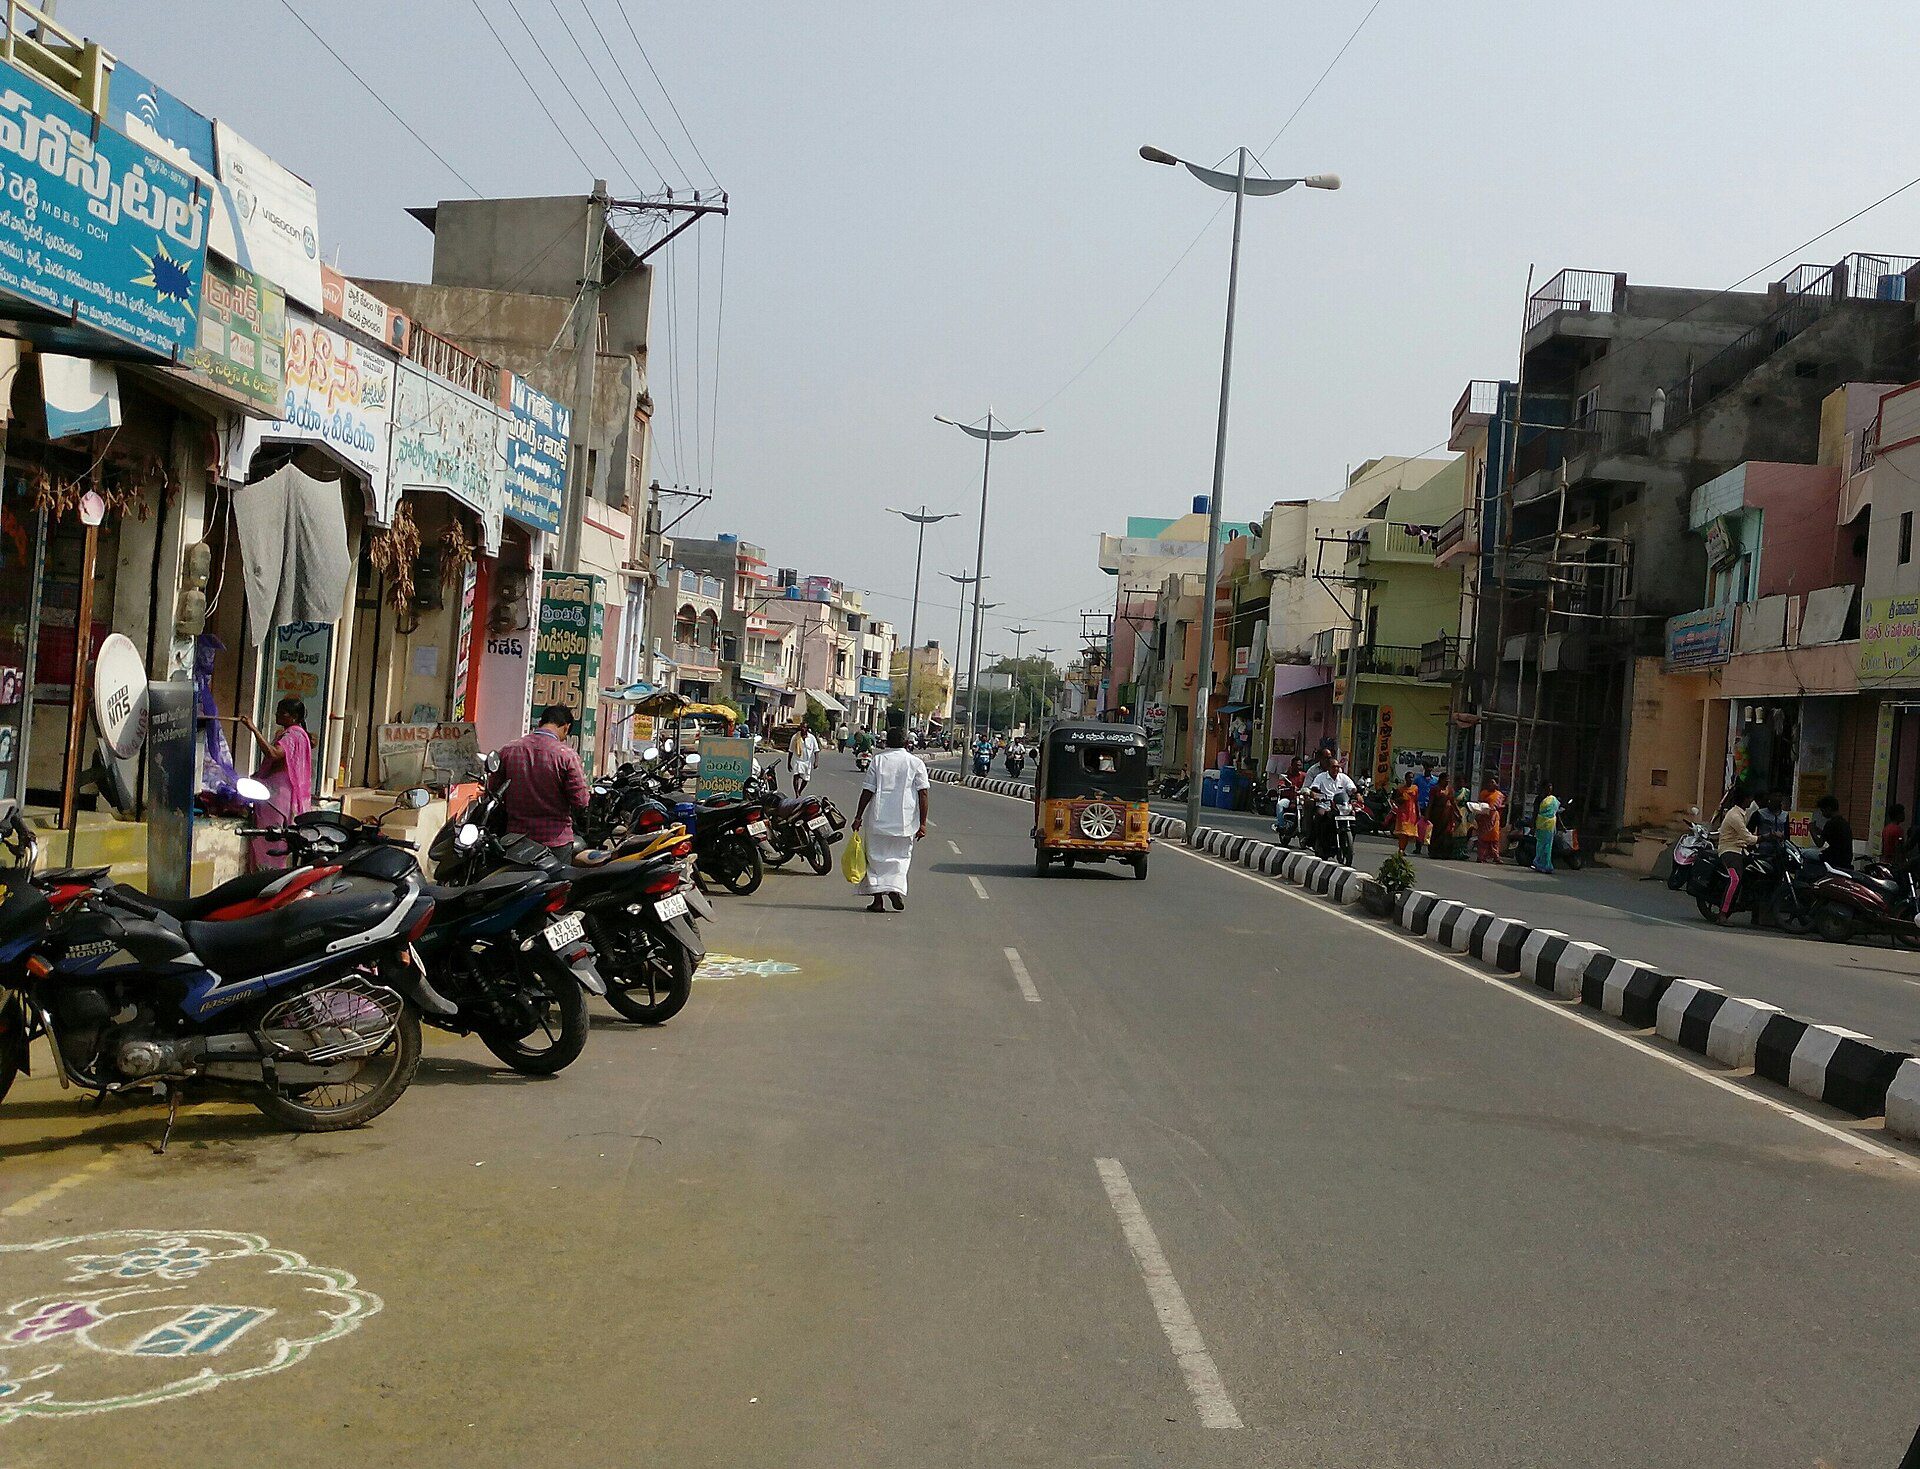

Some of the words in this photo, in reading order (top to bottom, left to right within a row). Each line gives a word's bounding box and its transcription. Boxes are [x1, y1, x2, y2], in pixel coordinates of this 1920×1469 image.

[87, 223, 110, 243] DCH
[487, 638, 523, 658] గణేష్
[553, 922, 564, 936] AP
[555, 924, 583, 948] AZ2397
[65, 942, 119, 959] HONDA
